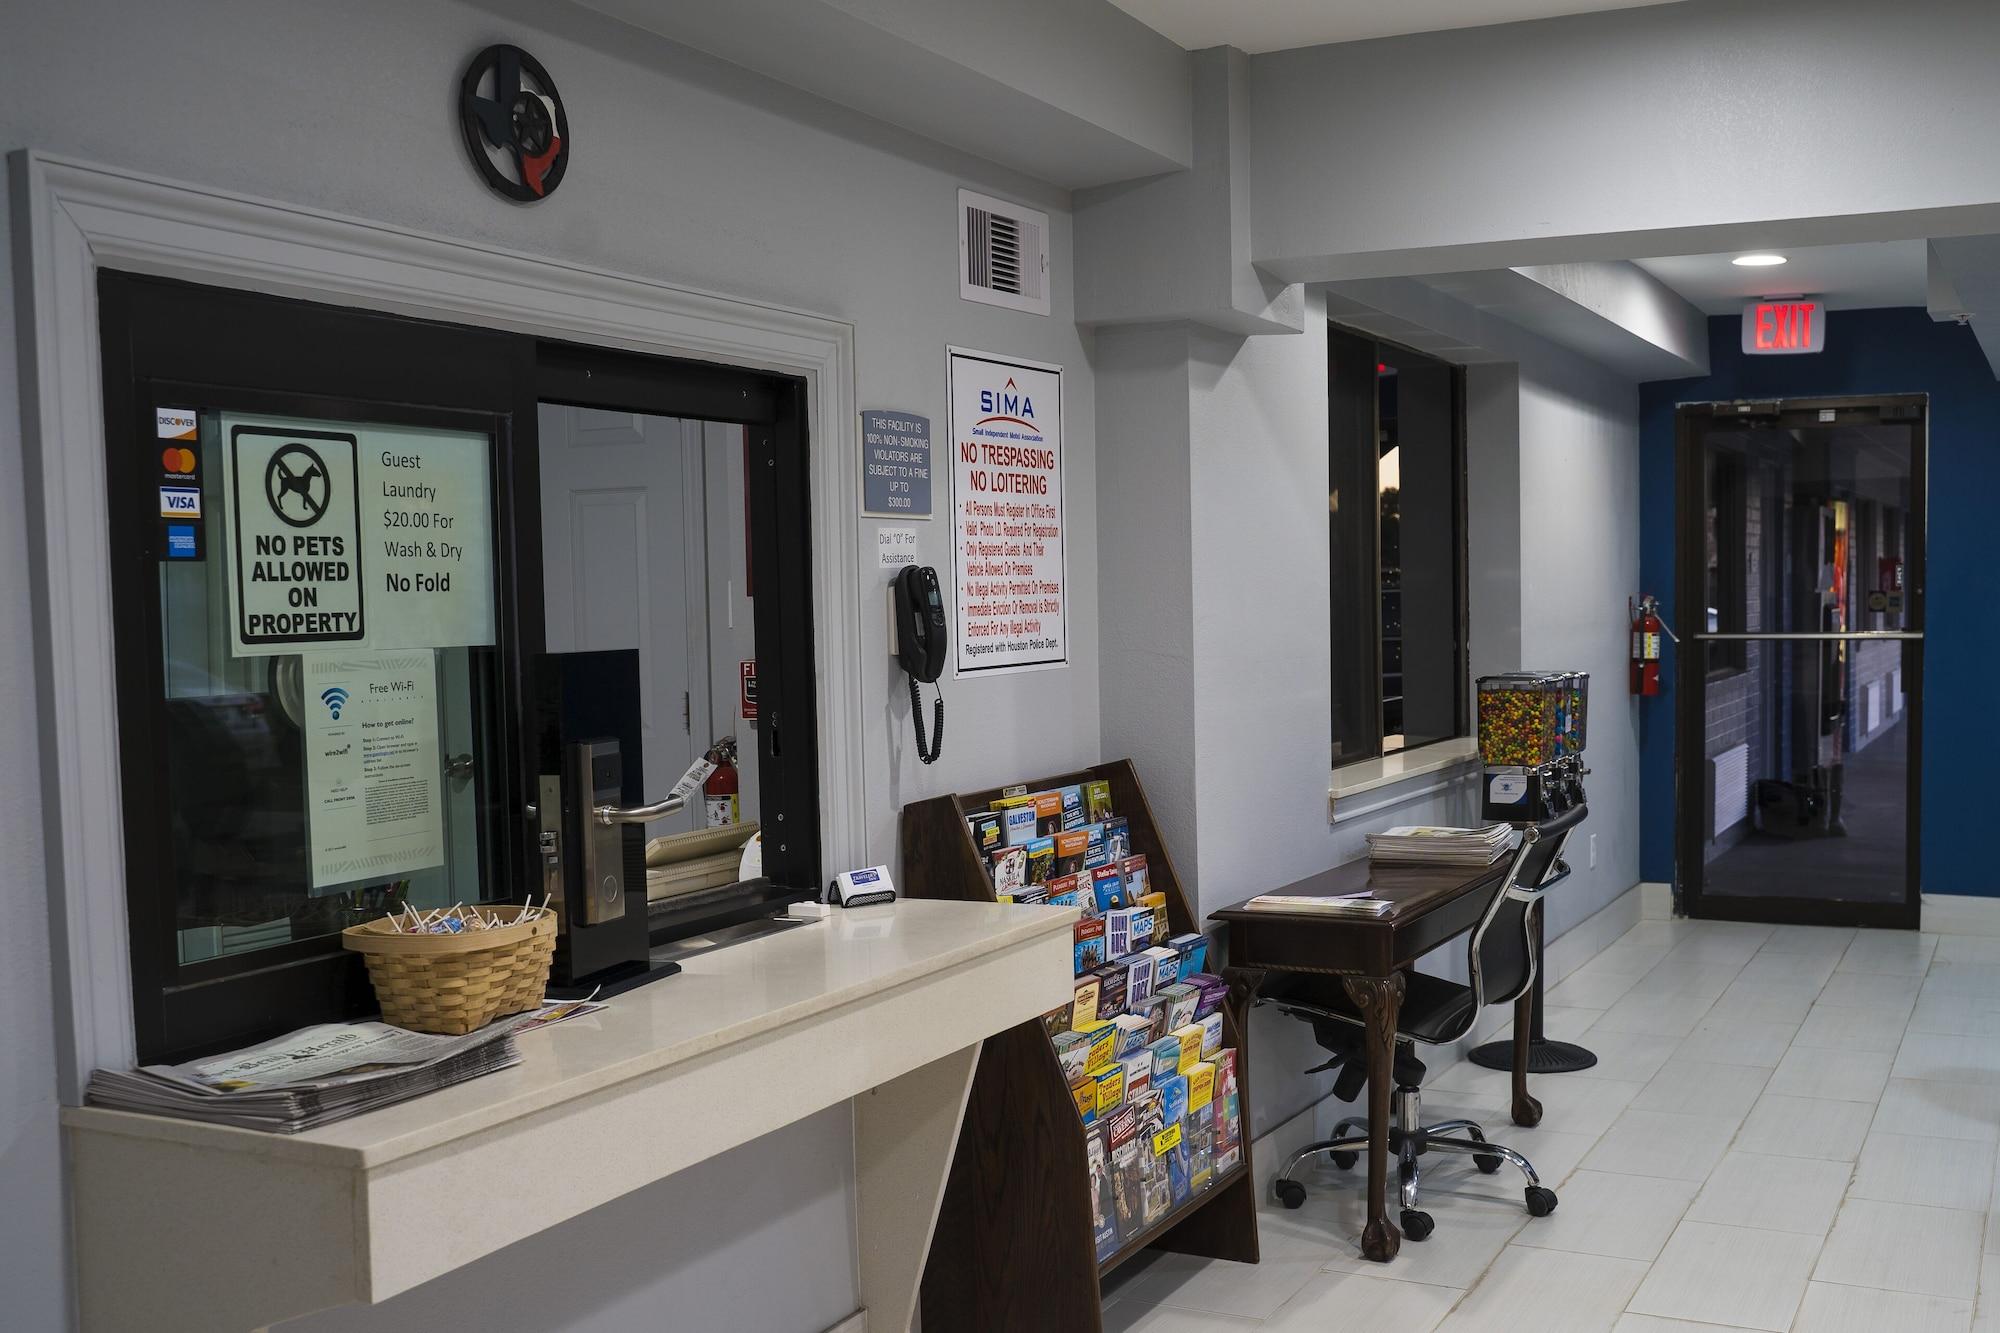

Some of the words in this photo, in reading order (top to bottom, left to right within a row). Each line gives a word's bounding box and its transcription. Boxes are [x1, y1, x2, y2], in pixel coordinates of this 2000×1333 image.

[1756, 304, 1815, 348] EXIT
[981, 390, 1034, 418] SIMA
[159, 417, 194, 427] DISCOVER
[872, 418, 886, 430] THIS
[888, 419, 914, 433] FACILITY
[915, 423, 922, 433] IS
[867, 433, 882, 445] 100%
[884, 434, 929, 449] NON-SMOKING
[972, 428, 984, 436] Small
[985, 430, 1008, 438] Independent
[1010, 432, 1020, 440] Motel
[1022, 434, 1043, 442] Association
[382, 452, 421, 469] Guest
[874, 449, 909, 463] VIOLATORS
[910, 453, 923, 464] ARE
[961, 442, 978, 464] NO
[981, 444, 1054, 470] TRESPASSING
[868, 464, 898, 477] SUBJECT
[899, 466, 907, 477] TO
[908, 468, 914, 478] A
[915, 468, 929, 479] FINE
[383, 481, 436, 502] Laundry
[890, 482, 899, 492] UP
[899, 482, 910, 493] TO
[970, 470, 987, 492] NO
[991, 472, 1047, 495] LOITERING
[166, 496, 196, 509] VISA
[888, 497, 911, 508] $300.00
[974, 501, 993, 517] Persons
[994, 501, 1005, 517] Must
[1006, 502, 1025, 521] Register
[1026, 504, 1030, 518] In
[1031, 503, 1045, 518] Office
[1046, 504, 1056, 519] First
[384, 509, 429, 529] $20.00
[433, 513, 454, 529] For
[880, 533, 892, 544] Dial
[905, 534, 916, 544] For
[966, 520, 978, 536] Valid
[980, 521, 994, 536] Photo
[1003, 521, 1024, 540] Required
[1024, 522, 1032, 537] For
[1033, 523, 1058, 541] Registration
[256, 535, 286, 556] NO
[294, 536, 345, 557] PETS
[384, 541, 422, 557] Wash
[426, 542, 437, 557] &
[441, 543, 463, 561] Dry
[966, 541, 977, 560] Only
[979, 541, 1003, 560] Registered
[1005, 541, 1020, 556] Guests
[1023, 541, 1032, 556] And
[1033, 541, 1044, 556] Their
[881, 553, 914, 564] Assistance
[252, 561, 349, 582] ALLOWED
[967, 561, 983, 576] Vehicle
[985, 561, 1003, 576] Allowed
[1005, 561, 1011, 576] On
[1012, 561, 1033, 576] Premises
[386, 573, 411, 592] No
[416, 572, 450, 592] Fold
[967, 581, 974, 597] No
[975, 581, 988, 600] Illegal
[990, 581, 1008, 599] Activity
[1009, 580, 1031, 595] Permitted
[1032, 580, 1038, 595] On
[1040, 580, 1059, 594] Premises
[288, 587, 317, 608] ON
[967, 601, 992, 617] Immediate
[993, 600, 1011, 616] Eviction
[1012, 600, 1018, 615] Or
[1020, 600, 1038, 615] Removal
[1044, 599, 1059, 616] Strictly
[249, 612, 357, 635] PROPERTY
[968, 622, 990, 638] Enforced
[991, 621, 999, 636] For
[1000, 620, 1008, 638] Any
[1010, 619, 1024, 638] Illegal
[1024, 619, 1041, 636] Activity
[966, 642, 994, 657] Registered
[995, 641, 1006, 652] with
[1008, 641, 1028, 652] Houston
[1030, 639, 1044, 650] Police
[1046, 638, 1059, 650] Dept.
[369, 683, 389, 694] Free
[391, 681, 414, 692] Wi-Fi
[384, 721, 394, 729] get
[395, 718, 415, 727] online?
[1009, 811, 1035, 826] GALVESTON
[1133, 917, 1153, 936] MAPS
[1159, 961, 1178, 978] MAPS
